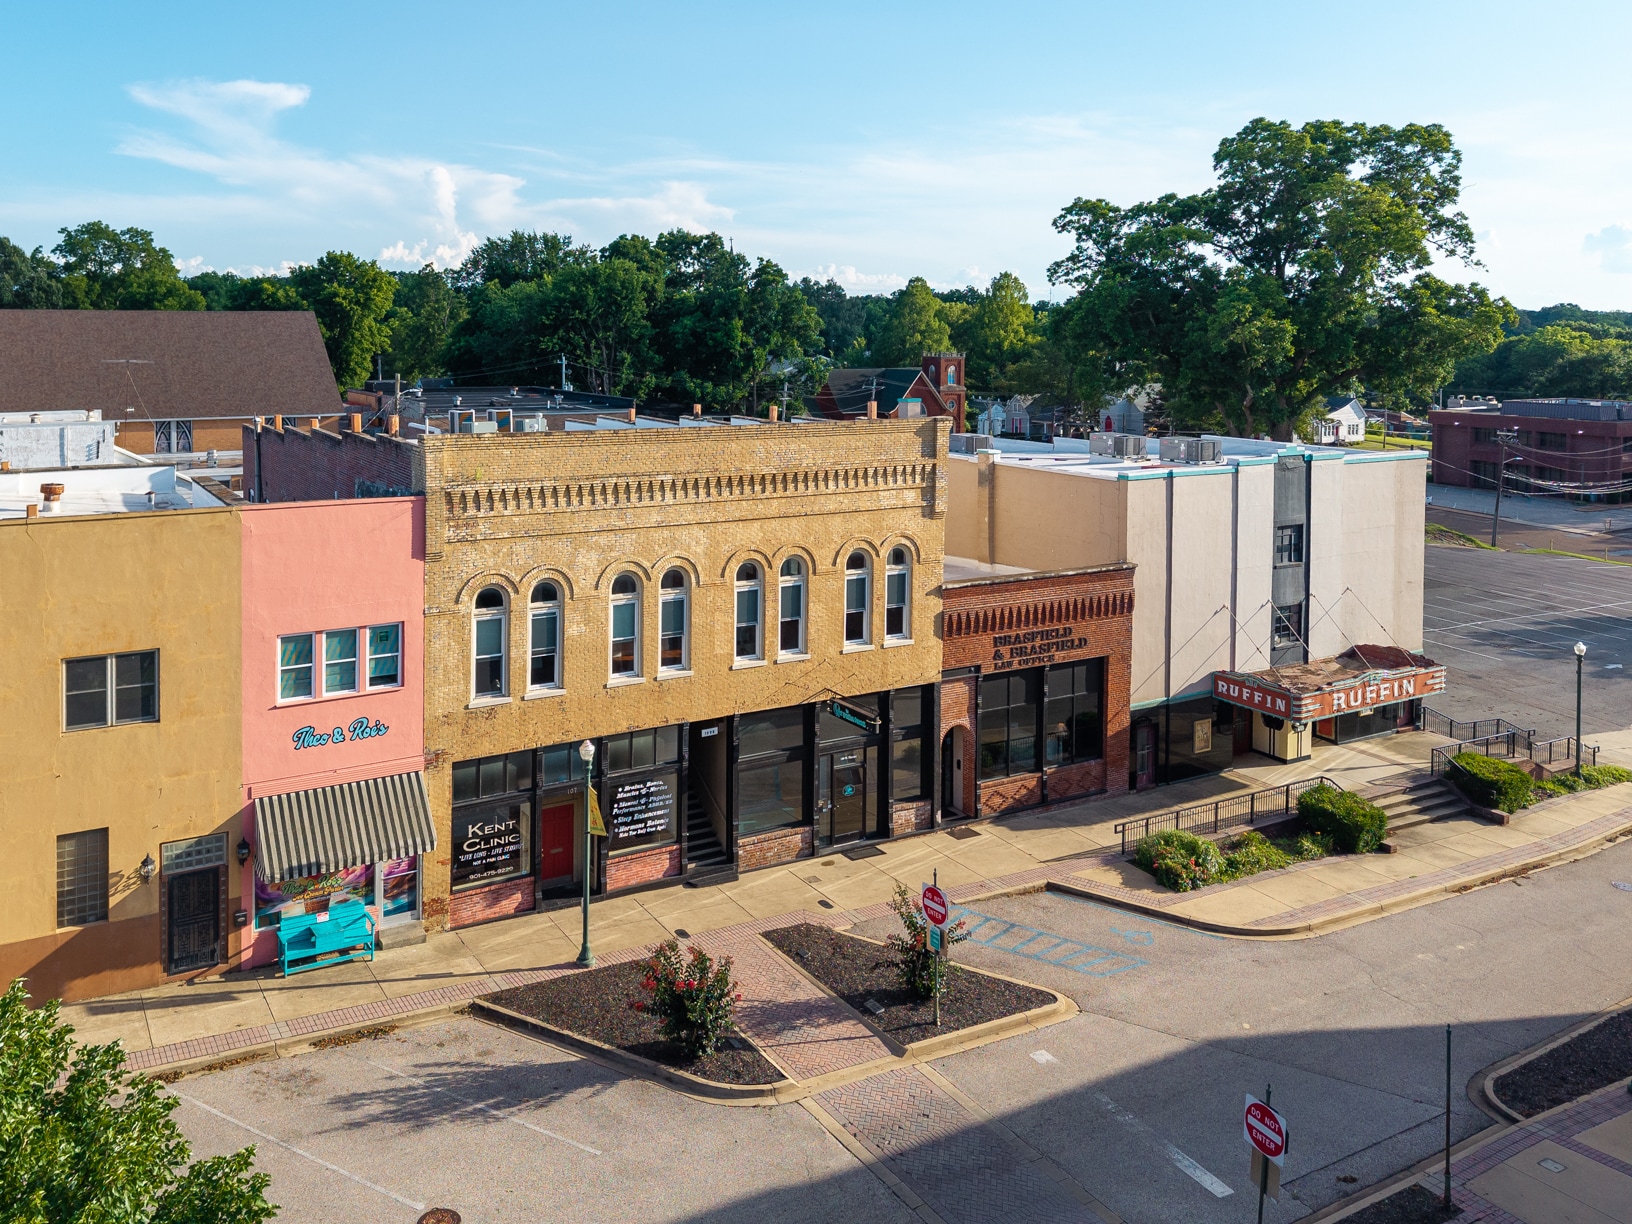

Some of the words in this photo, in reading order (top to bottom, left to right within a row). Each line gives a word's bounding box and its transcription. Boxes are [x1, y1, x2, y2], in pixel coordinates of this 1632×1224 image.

[992, 626, 1073, 648] BRASFIELD
[992, 648, 1004, 661] &
[1009, 637, 1089, 659] BRASFIELD
[993, 660, 1014, 670] LAW
[1018, 654, 1056, 667] OFFICE
[1217, 679, 1287, 713] RUFFIN
[1333, 678, 1415, 712] RUFFIN
[292, 725, 331, 750] Theo
[331, 726, 345, 744] &
[347, 716, 390, 741] Roe's
[567, 787, 578, 795] 107
[467, 820, 516, 838] KENT
[462, 834, 520, 852] CLINIC
[925, 890, 932, 899] DO
[933, 895, 943, 905] NOT
[927, 907, 942, 921] ENTER
[1250, 1106, 1261, 1119] DO
[1264, 1116, 1280, 1132] NOT
[1252, 1129, 1276, 1151] ENTER
